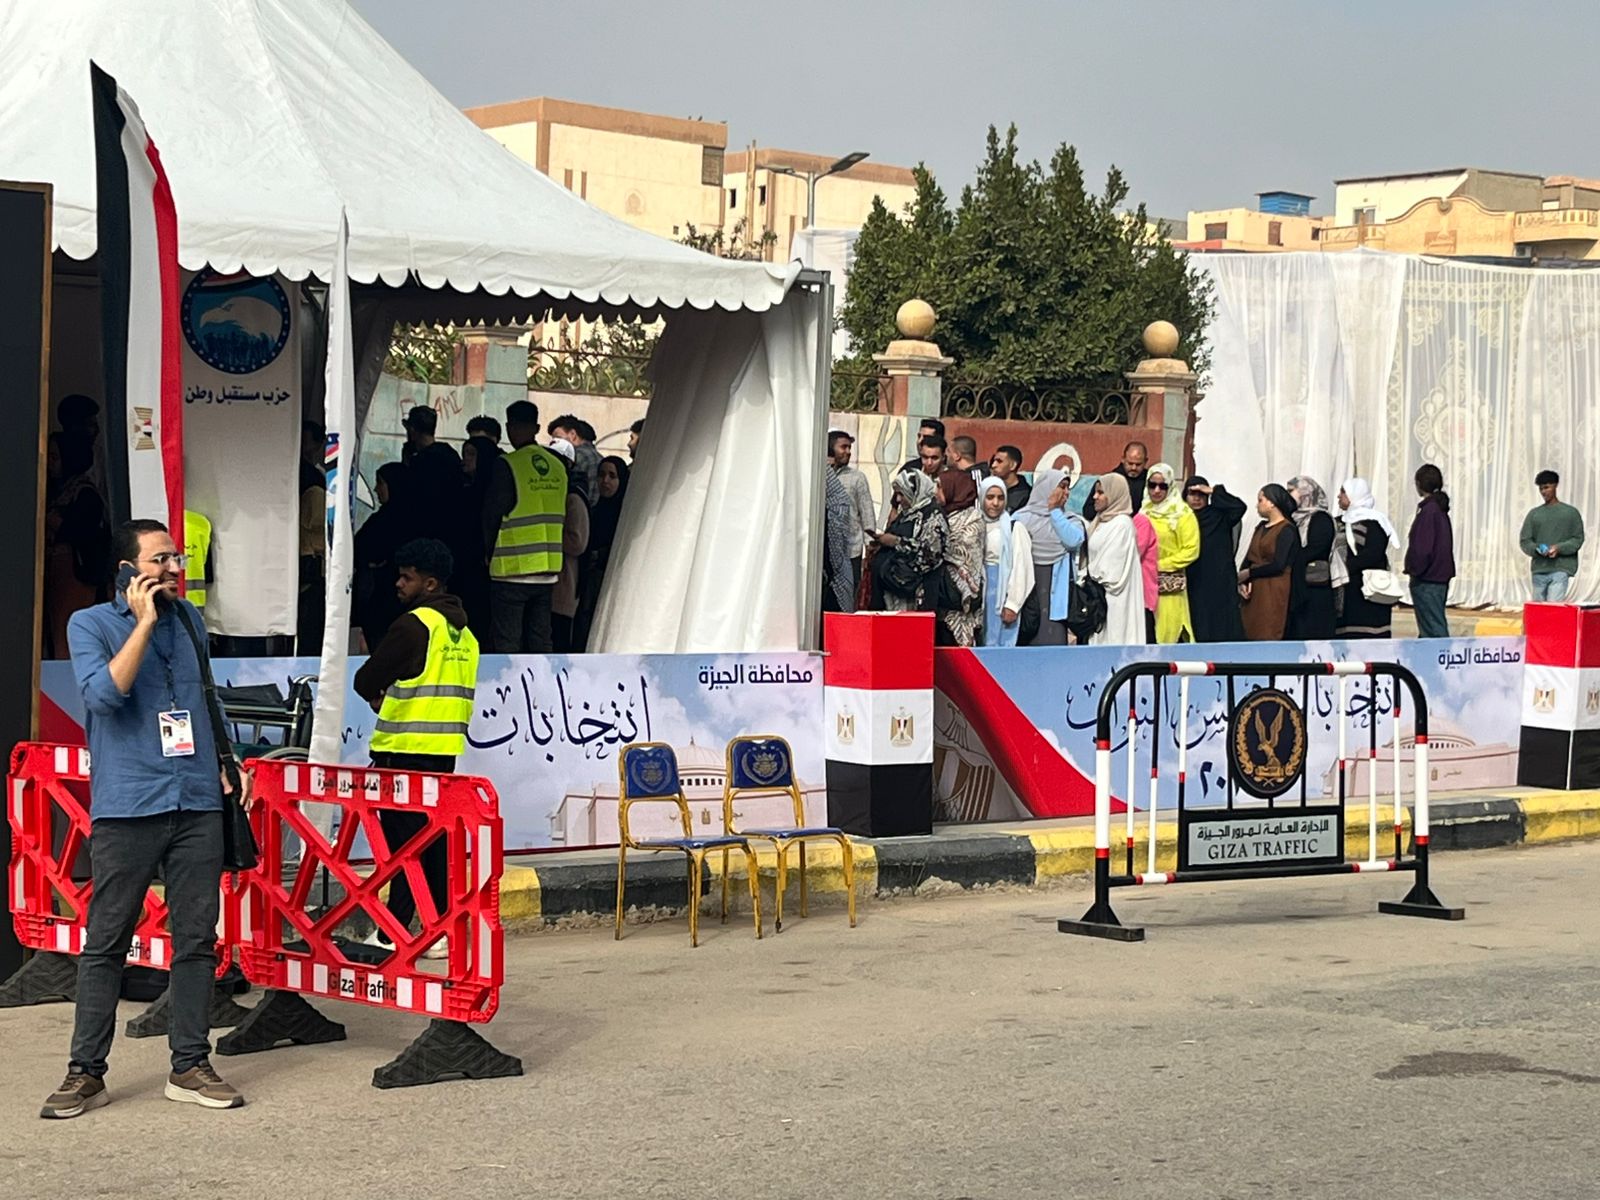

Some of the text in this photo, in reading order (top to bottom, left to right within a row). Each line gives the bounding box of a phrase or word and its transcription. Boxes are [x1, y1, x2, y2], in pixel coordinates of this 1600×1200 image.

[185, 385, 291, 405] حزب مستقبل وطن
[1438, 647, 1521, 670] محافظة الجيزة
[698, 663, 813, 690] محافظة الجيزة
[466, 667, 652, 763] انتخابات
[1197, 825, 1230, 841] الجيزة
[1231, 823, 1261, 839] لمرور
[1263, 820, 1299, 836] العامة
[1208, 839, 1318, 859] GIZA TRAFFIC
[357, 976, 396, 1000] Traffic
